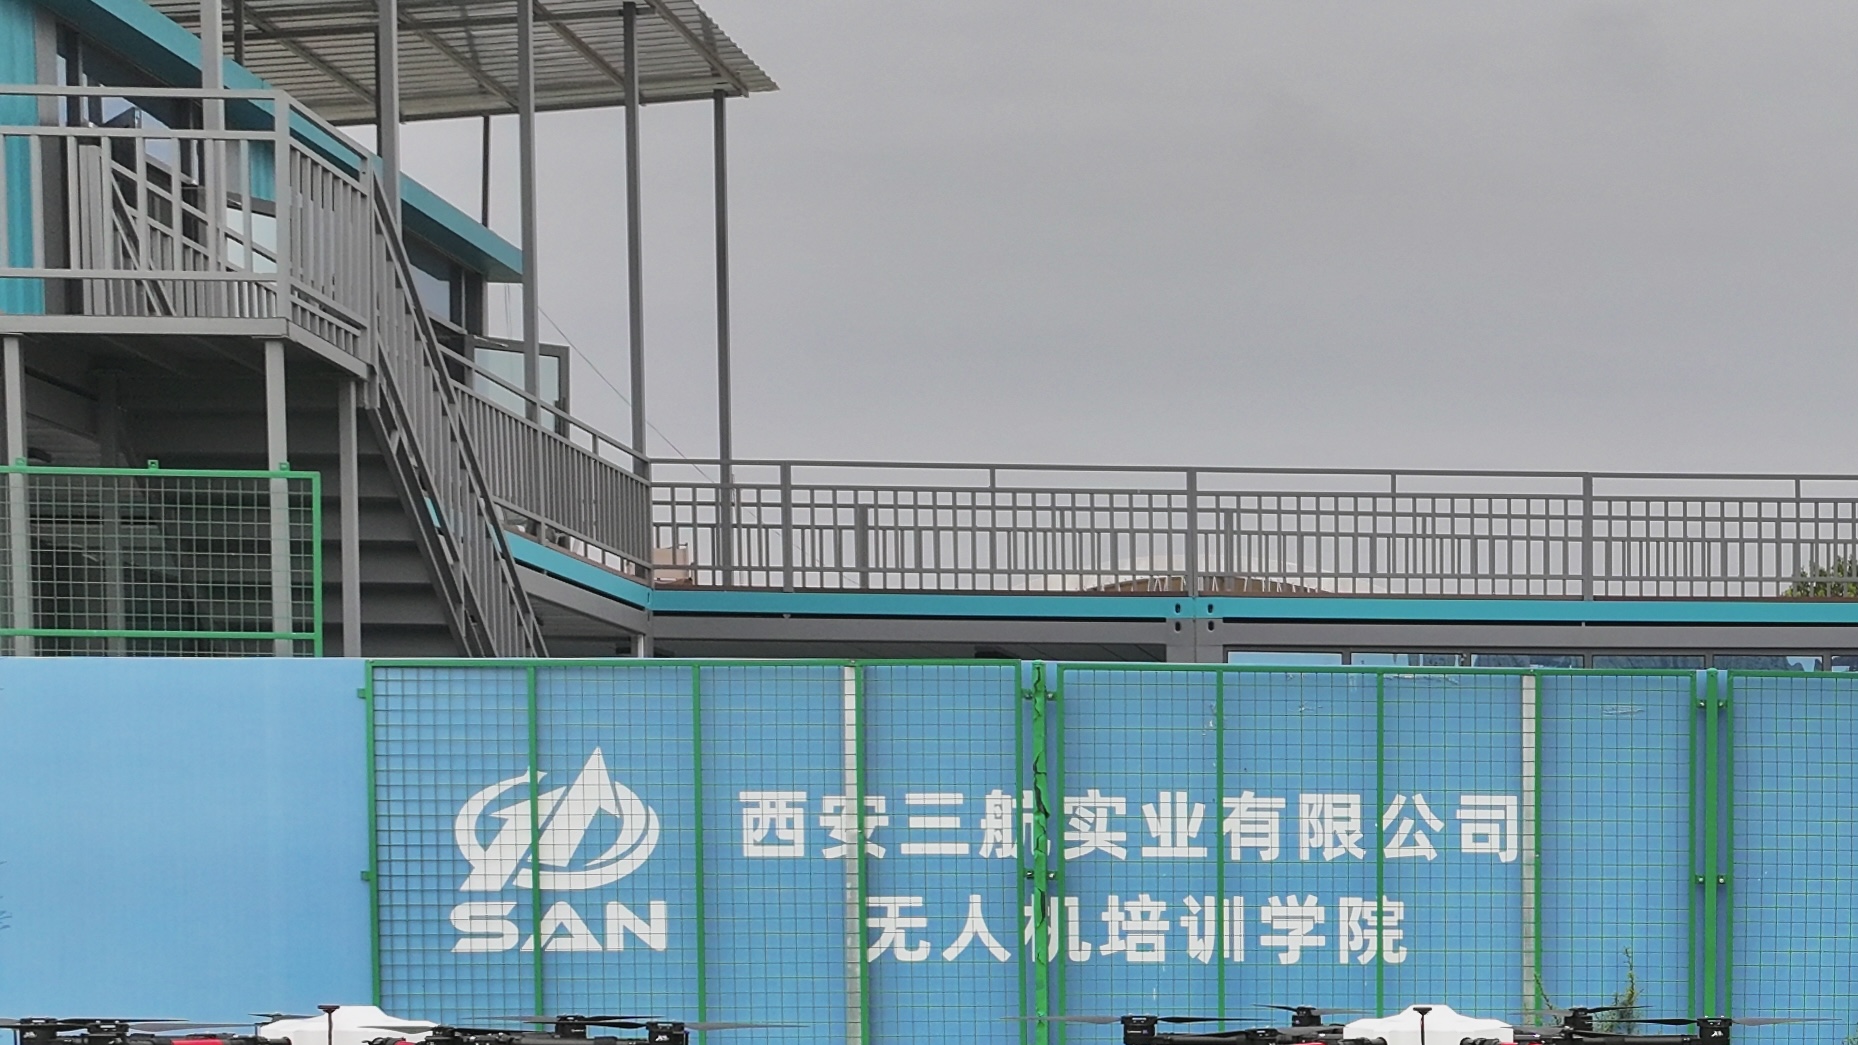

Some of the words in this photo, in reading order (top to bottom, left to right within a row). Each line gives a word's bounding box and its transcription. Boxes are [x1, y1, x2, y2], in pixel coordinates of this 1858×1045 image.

[451, 900, 668, 952] SAN
[867, 894, 1407, 965] 无人机培训学院
